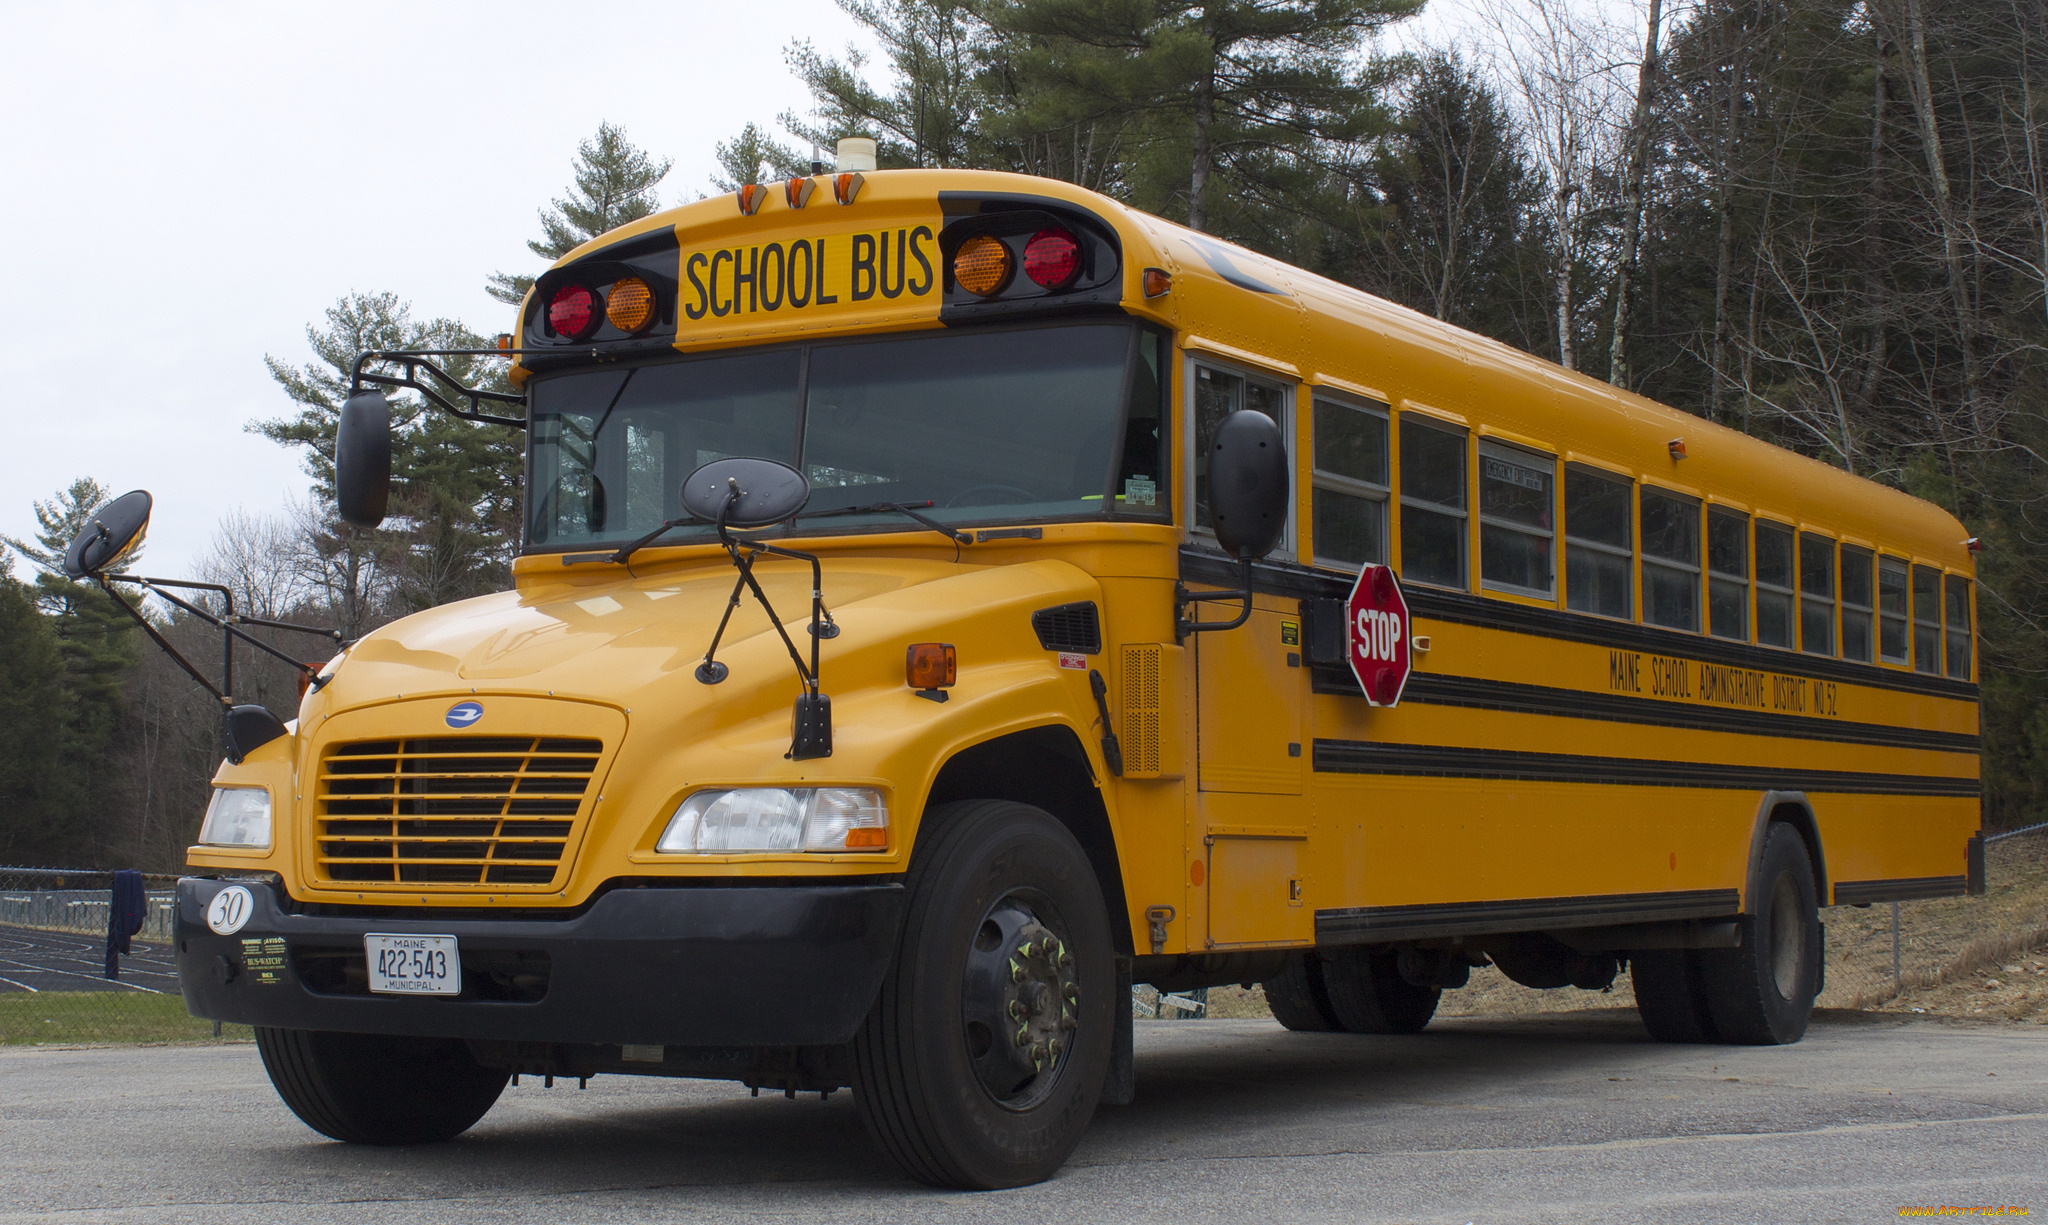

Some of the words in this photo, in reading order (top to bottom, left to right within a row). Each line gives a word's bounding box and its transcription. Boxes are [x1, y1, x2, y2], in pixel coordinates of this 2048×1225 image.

[685, 239, 838, 320] SCHOOL
[851, 225, 934, 302] BUS
[1357, 607, 1401, 662] STOP
[1610, 650, 1641, 693] MAINE
[1652, 656, 1691, 698] SCHOOL
[1700, 664, 1766, 708] ADMINISTRATIVE
[1773, 675, 1806, 712] DISTRICT
[1827, 682, 1837, 716] 52
[212, 891, 244, 928] 30
[394, 939, 427, 949] MAINE
[388, 980, 435, 991] MUNICIPAL
